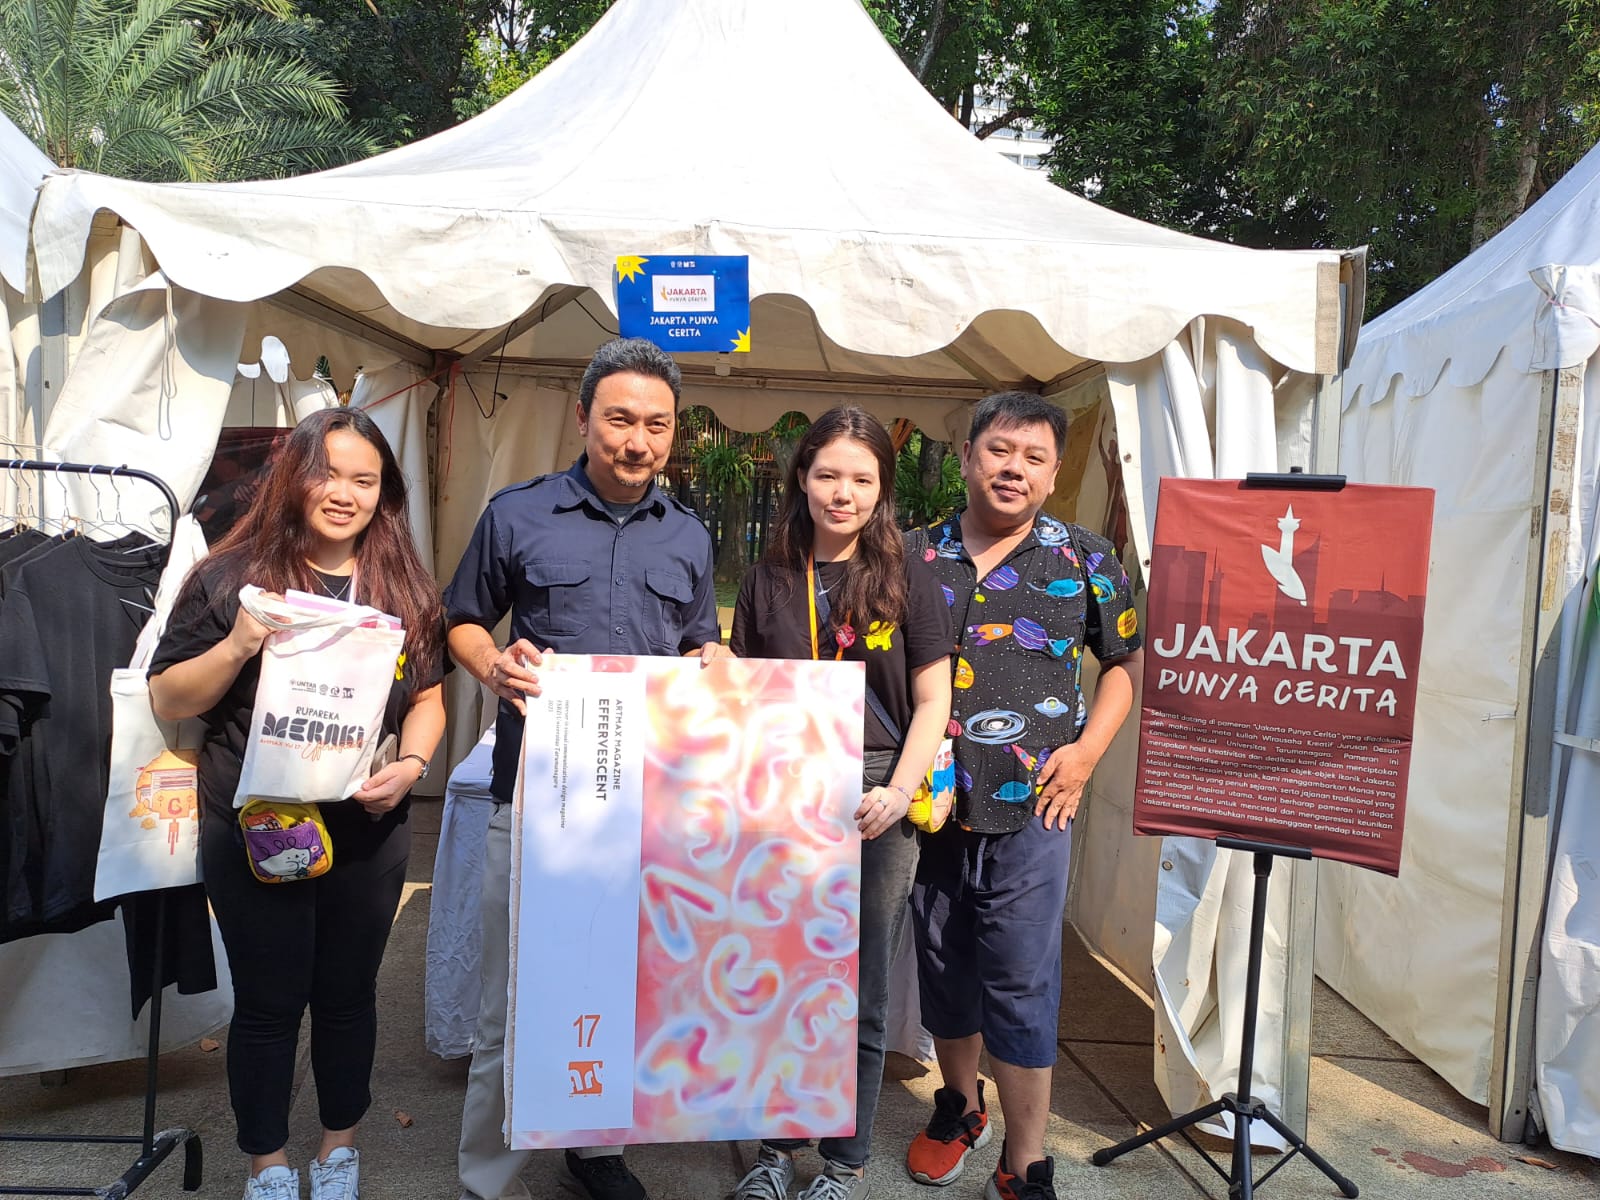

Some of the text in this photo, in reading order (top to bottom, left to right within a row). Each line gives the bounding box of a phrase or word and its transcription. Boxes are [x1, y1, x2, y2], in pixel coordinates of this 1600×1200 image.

[650, 316, 718, 325] JAKARTA PUNYA
[1154, 623, 1406, 680] JAKARTA
[1158, 668, 1398, 717] PUNYA CERITA
[296, 706, 339, 720] RUPAREKA
[1151, 710, 1179, 720] Selamat
[1182, 715, 1206, 725] datang
[1218, 720, 1250, 730] pameran
[1288, 728, 1311, 736] Punya
[1342, 734, 1361, 742] yang
[1364, 736, 1400, 744] diadakan
[596, 698, 610, 801] EFFERVESCENT
[612, 699, 623, 790] ARTMAX MAGAZINE
[1149, 729, 1188, 740] Komunikasi
[1196, 736, 1217, 744] Visual
[1226, 740, 1266, 751] Universitas
[1343, 753, 1379, 763] Pameran
[1389, 758, 1399, 766] ini
[1168, 723, 1207, 734] mahasiswa
[1236, 732, 1258, 740] kuliah
[1262, 735, 1302, 745] Wirausaha
[1307, 740, 1334, 748] Kreatif
[1337, 743, 1368, 751] Jurusan
[1373, 746, 1400, 754] Desain
[1146, 750, 1170, 758] produk
[1173, 754, 1218, 765] merchandise
[1220, 760, 1238, 768] yang
[1241, 763, 1288, 773] mengangkat
[1291, 767, 1335, 780] objek-objek
[1338, 774, 1360, 782] ikonik
[1148, 740, 1187, 750] merupakan
[1208, 747, 1246, 759] kreativitas
[1265, 754, 1296, 763] dedikasi
[1319, 760, 1344, 769] dalam
[1346, 764, 1398, 776] menciptakan
[560, 784, 568, 802] design
[1146, 759, 1171, 768] Melalui
[1173, 763, 1223, 774] desain-desain
[1224, 770, 1242, 778] yang
[1282, 777, 1347, 791] menggambarkan
[1376, 790, 1396, 799] yang
[1206, 777, 1223, 785] yang
[1225, 780, 1248, 788] penuh
[1300, 790, 1331, 800] jajanan
[1332, 795, 1373, 805] tradisional
[1374, 800, 1395, 809] yang
[1144, 789, 1192, 801] menginspirasi
[1216, 799, 1237, 807] untuk
[1240, 803, 1277, 813] mencintai
[1298, 811, 1354, 824] mengapresiasi
[1358, 820, 1393, 830] keunikan
[1145, 778, 1162, 786] lezat
[1165, 781, 1193, 790] sebagai
[1197, 785, 1225, 795] inspirasi
[1258, 794, 1276, 802] Kami
[1280, 798, 1314, 809] berharap
[1318, 804, 1353, 814] pameran
[1369, 810, 1394, 819] dapat
[1142, 799, 1171, 808] Jakarta
[1192, 806, 1245, 819] menumbuhkan
[1265, 817, 1312, 829] kebanggaan
[1314, 824, 1350, 835] terhadap
[1352, 829, 1370, 837] kota
[573, 1014, 601, 1048] 17
